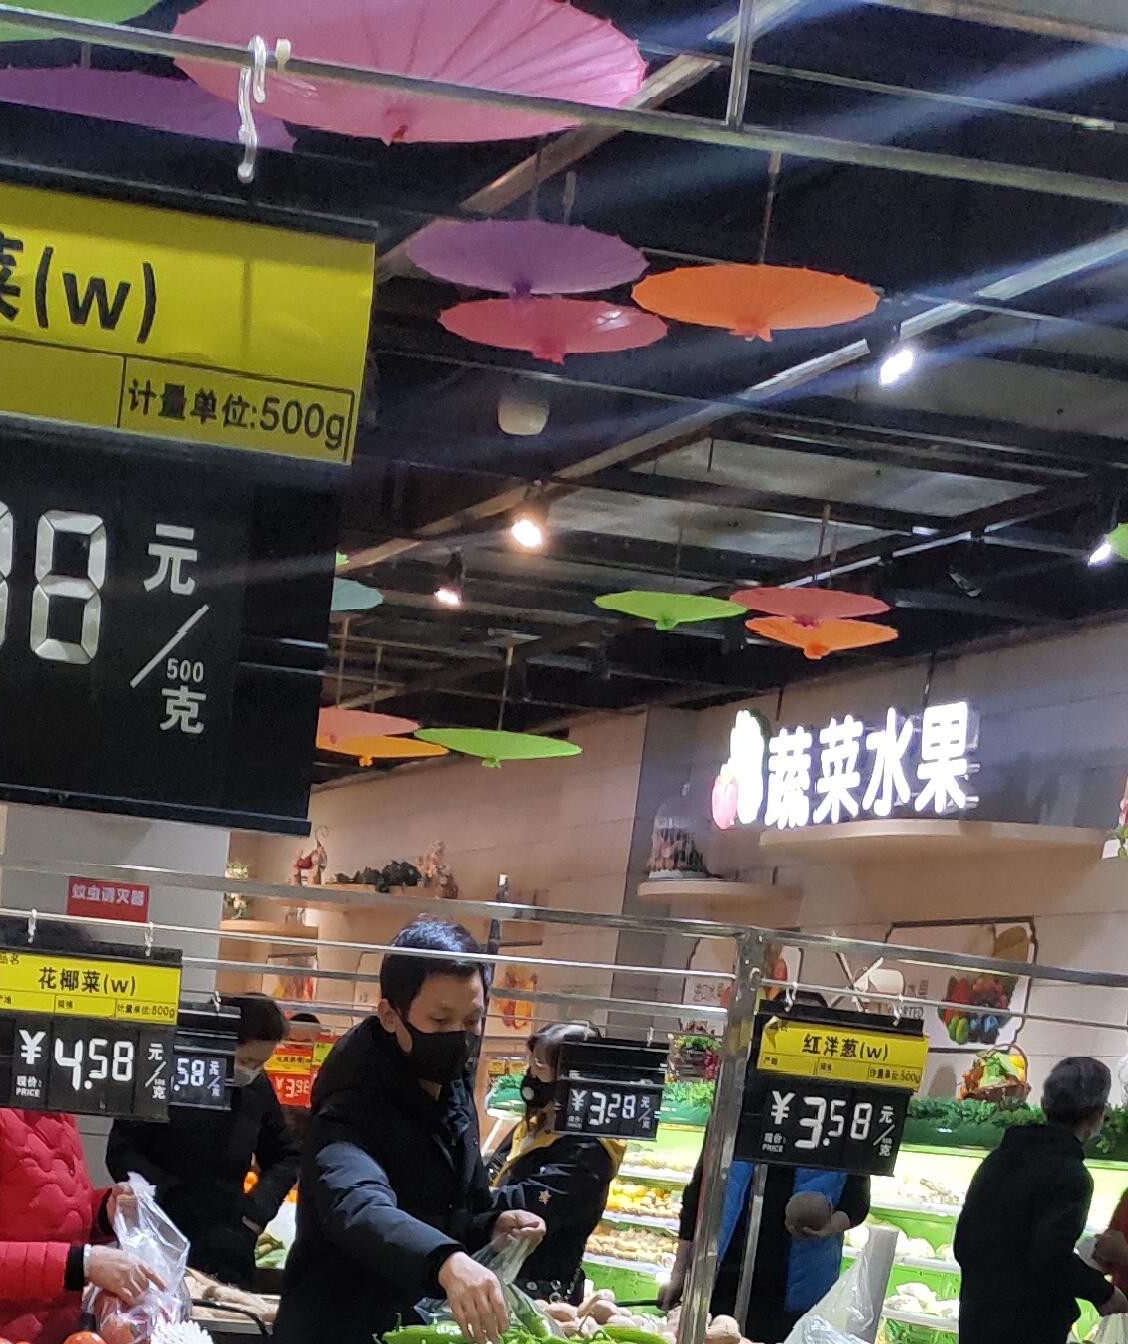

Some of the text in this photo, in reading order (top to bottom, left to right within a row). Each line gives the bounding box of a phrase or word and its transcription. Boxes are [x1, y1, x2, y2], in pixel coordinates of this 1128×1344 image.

[127, 380, 344, 450] 计量单位:500g
[166, 658, 204, 683] 500
[764, 702, 968, 830] 蔬菜水果
[38, 966, 136, 996] 花椰菜(w)
[54, 1038, 134, 1091] 4.58
[802, 1033, 888, 1061] 红洋葱(w)
[16, 1088, 41, 1098] PRICE
[794, 1096, 872, 1149] 3.58
